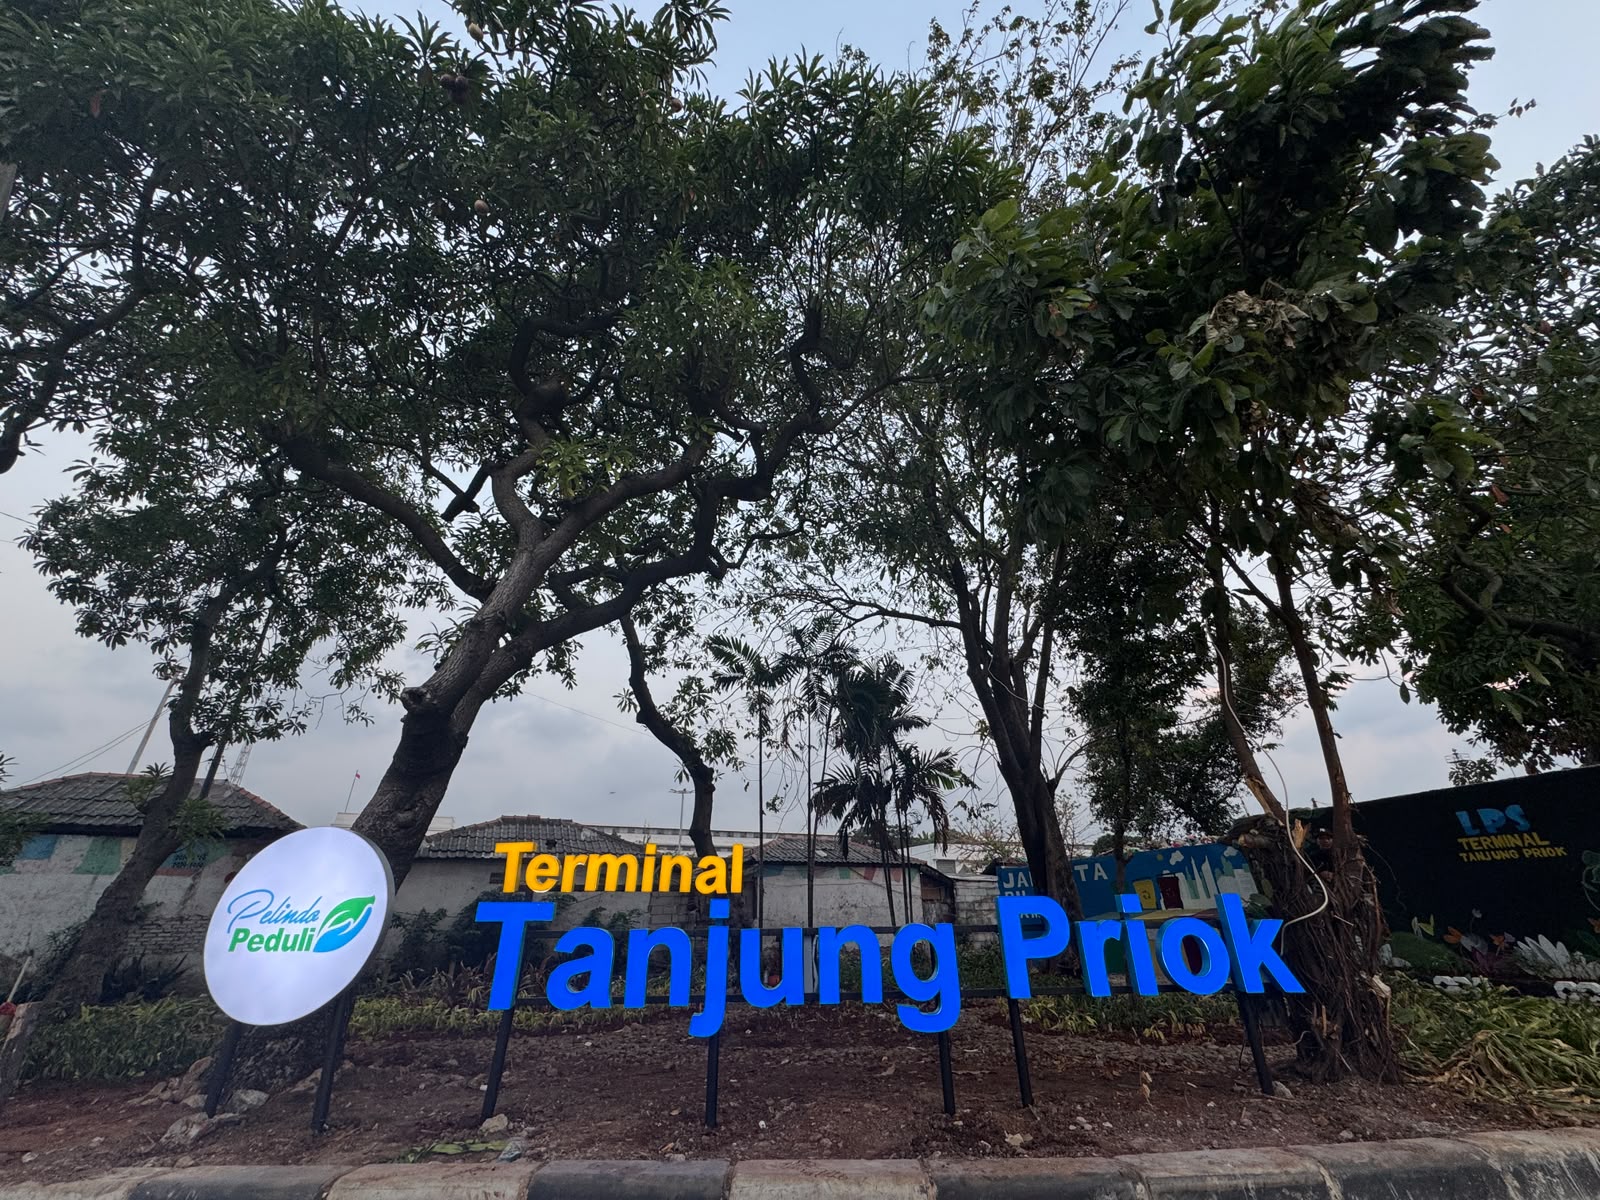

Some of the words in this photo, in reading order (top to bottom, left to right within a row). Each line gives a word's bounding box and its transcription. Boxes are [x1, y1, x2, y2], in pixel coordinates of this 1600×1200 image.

[1456, 804, 1531, 835] LPS
[1457, 832, 1550, 851] TERMINAL
[1459, 849, 1520, 863] TANJUNG
[1523, 846, 1568, 859] PRIOK
[494, 842, 744, 894] Terminal
[228, 928, 316, 952] Peduli
[475, 899, 961, 1038] Tanjung
[995, 892, 1306, 999] Priok
